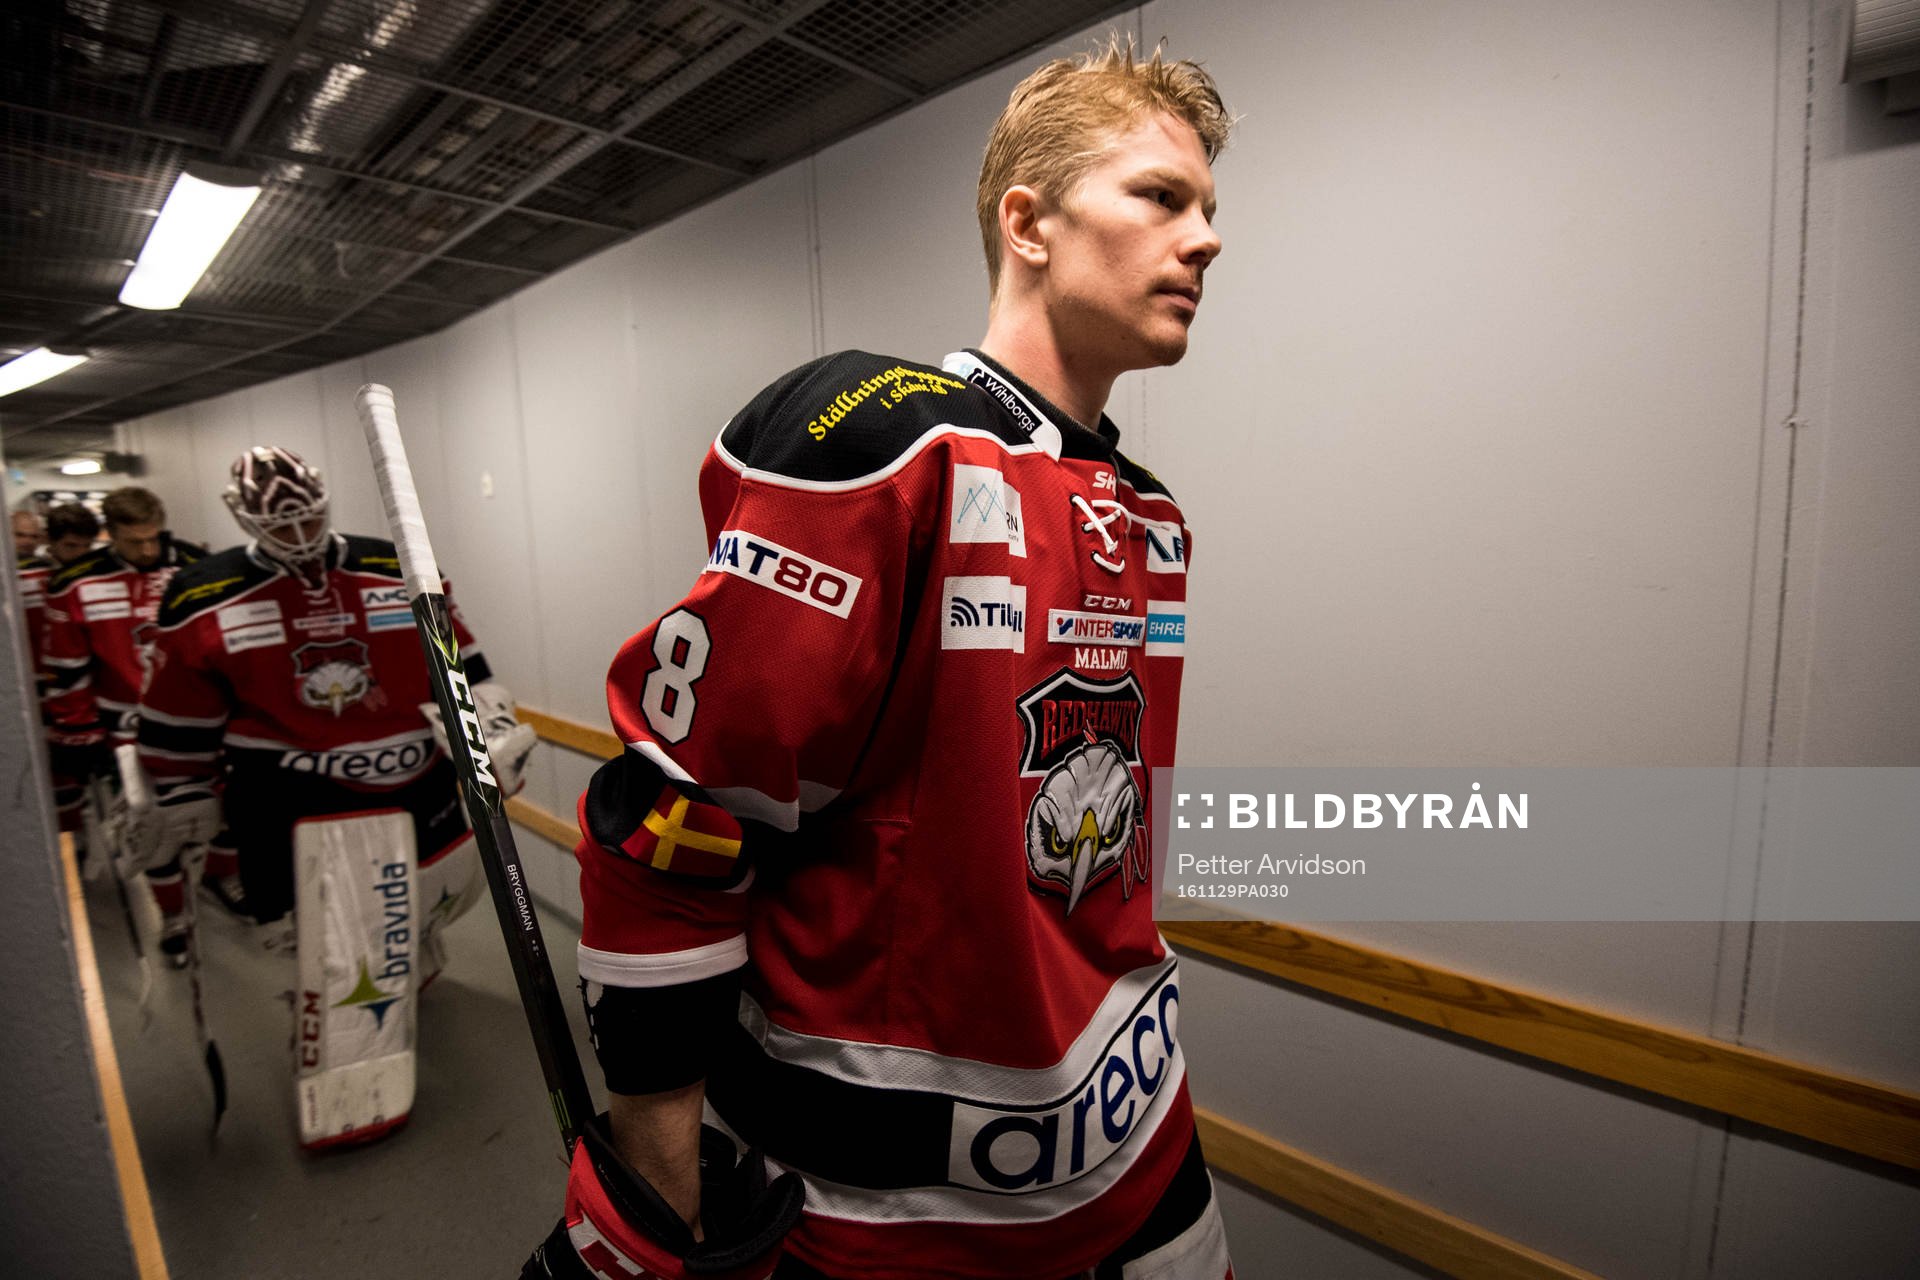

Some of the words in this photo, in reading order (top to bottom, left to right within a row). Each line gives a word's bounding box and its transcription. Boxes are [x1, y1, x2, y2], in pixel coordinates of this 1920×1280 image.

[985, 377, 1036, 432] Wihlborgs
[1074, 619, 1144, 640] INTERSPORT
[1084, 594, 1132, 611] CCM
[1074, 647, 1128, 670] MALMÖ
[448, 669, 498, 788] CCM
[1041, 700, 1138, 760] REDHAWKS
[287, 745, 421, 778] areco
[374, 862, 411, 981] bravida
[507, 864, 534, 931] BRYGGMAN
[302, 989, 321, 1068] CCM
